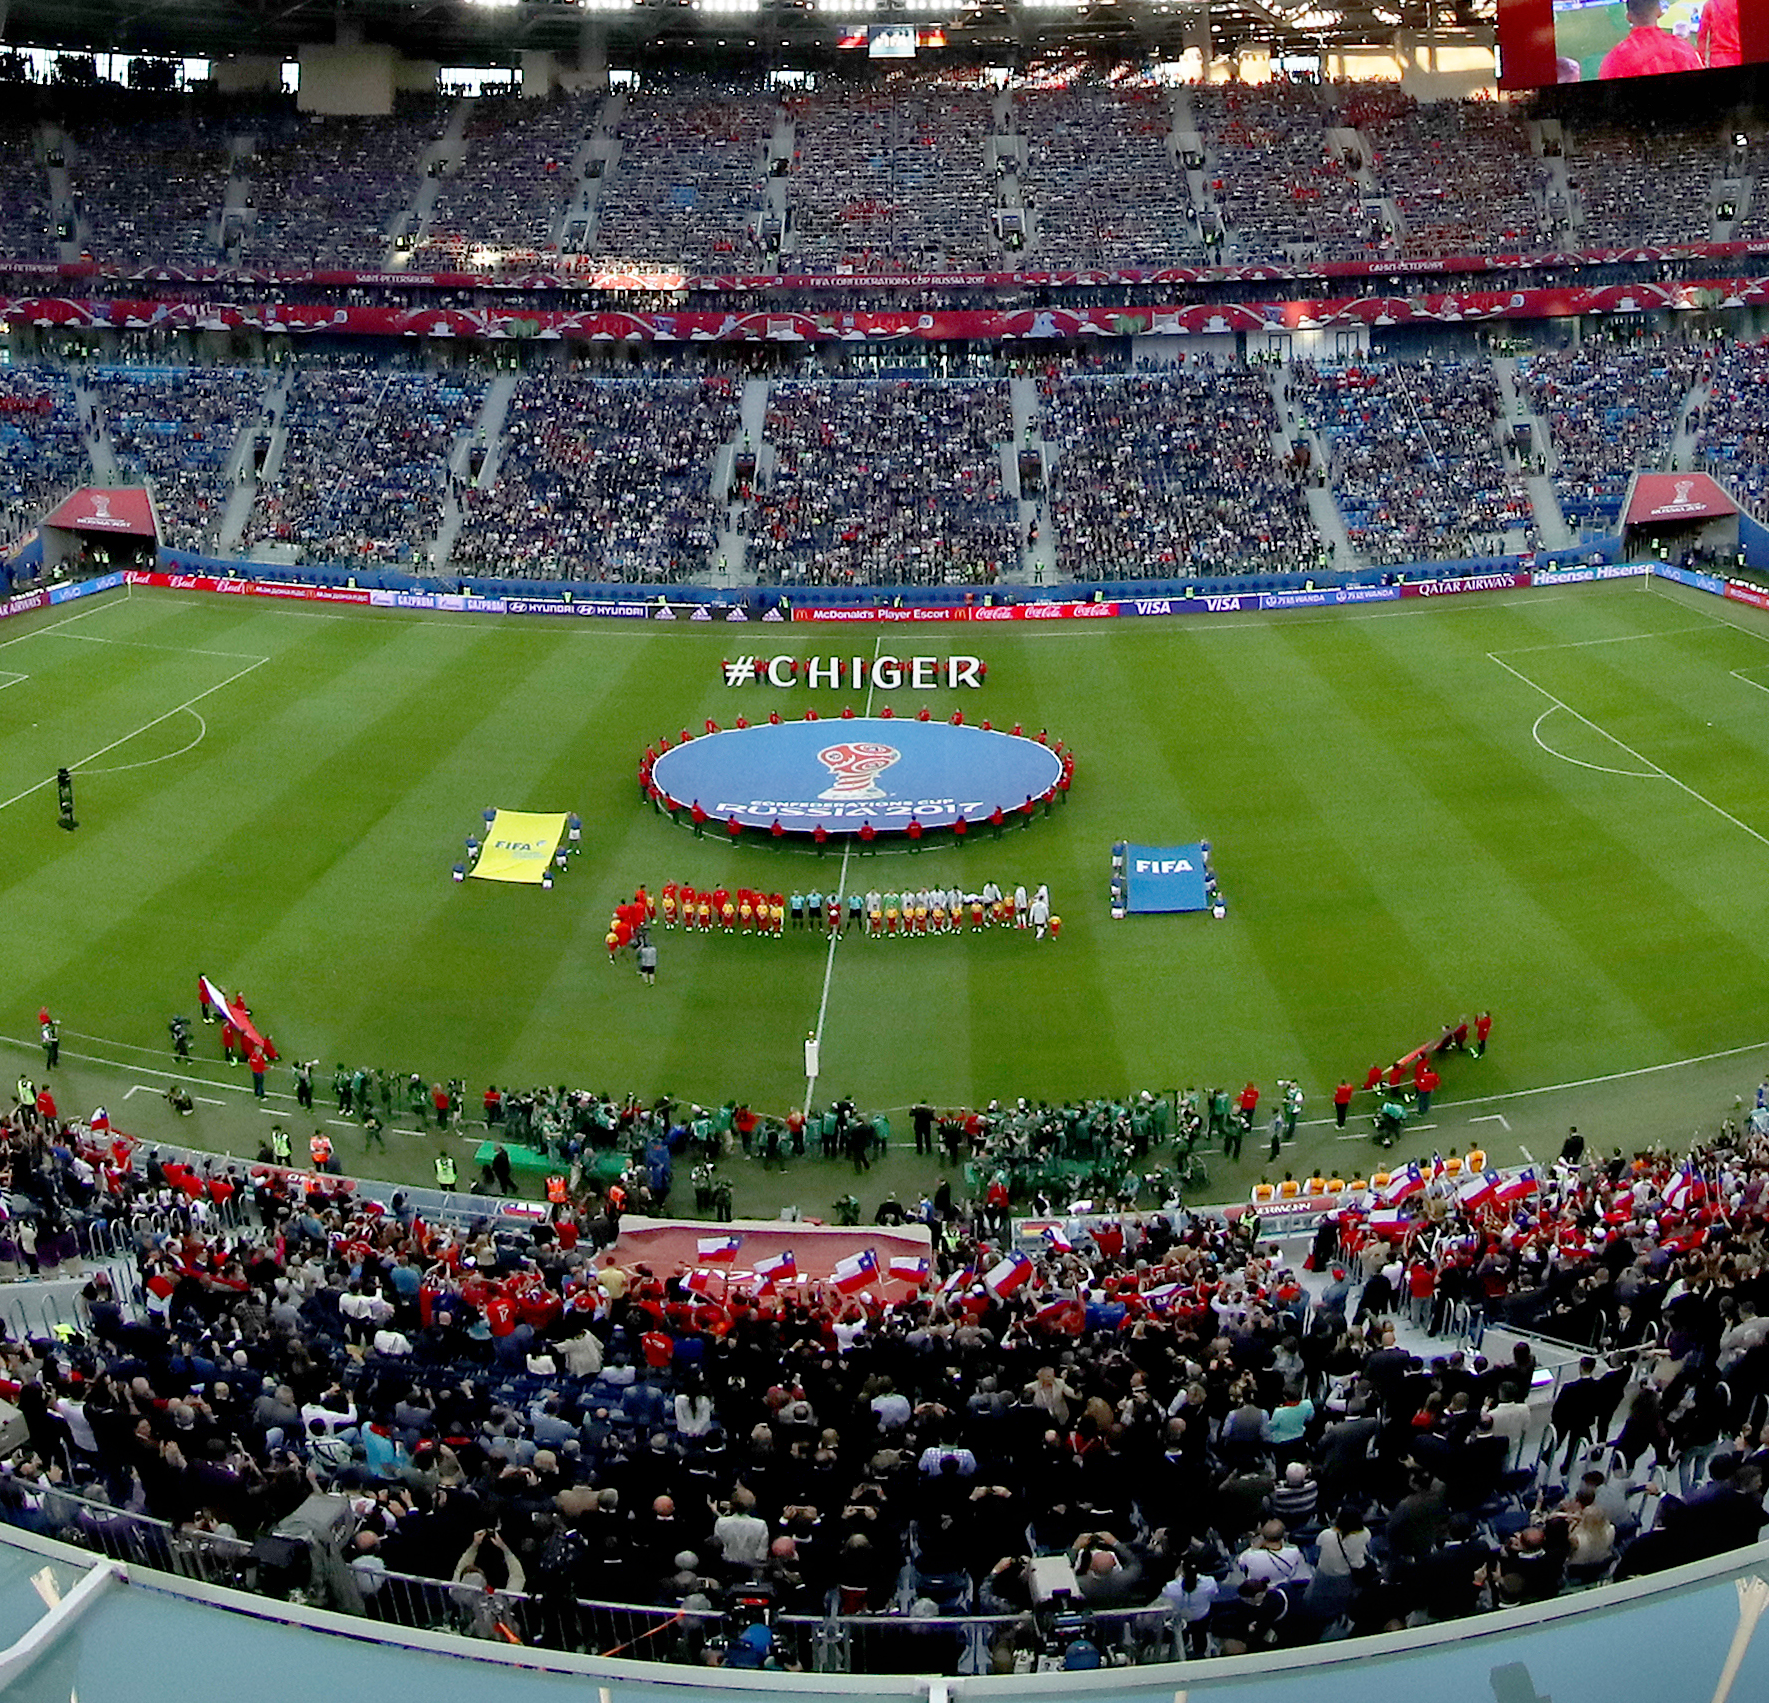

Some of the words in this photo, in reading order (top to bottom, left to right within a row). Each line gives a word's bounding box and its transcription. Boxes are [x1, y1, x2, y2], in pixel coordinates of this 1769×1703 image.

[1534, 570, 1594, 586] Hisense
[1597, 564, 1655, 579] Hisense
[168, 575, 196, 589] Bud
[213, 580, 243, 594] Bud
[1419, 581, 1461, 597] QATAR
[1463, 575, 1515, 592] AIRWAYS
[467, 599, 505, 611] GAZPROM
[529, 603, 575, 614] HYUNDAI
[597, 606, 643, 616] HYUNDAI
[1136, 601, 1171, 615] VISA
[1206, 598, 1241, 611] VISA
[813, 609, 874, 619] McDonald's
[878, 609, 910, 621] Player
[913, 608, 949, 619] Escort
[725, 655, 981, 689] #CHIGER
[715, 802, 878, 817] RUSSIA
[884, 801, 985, 817] 2017
[750, 800, 913, 808] CONFEDERATIONS
[495, 840, 531, 851] FIFA
[1135, 859, 1193, 875] FIFA
[499, 1309, 510, 1323] 17
